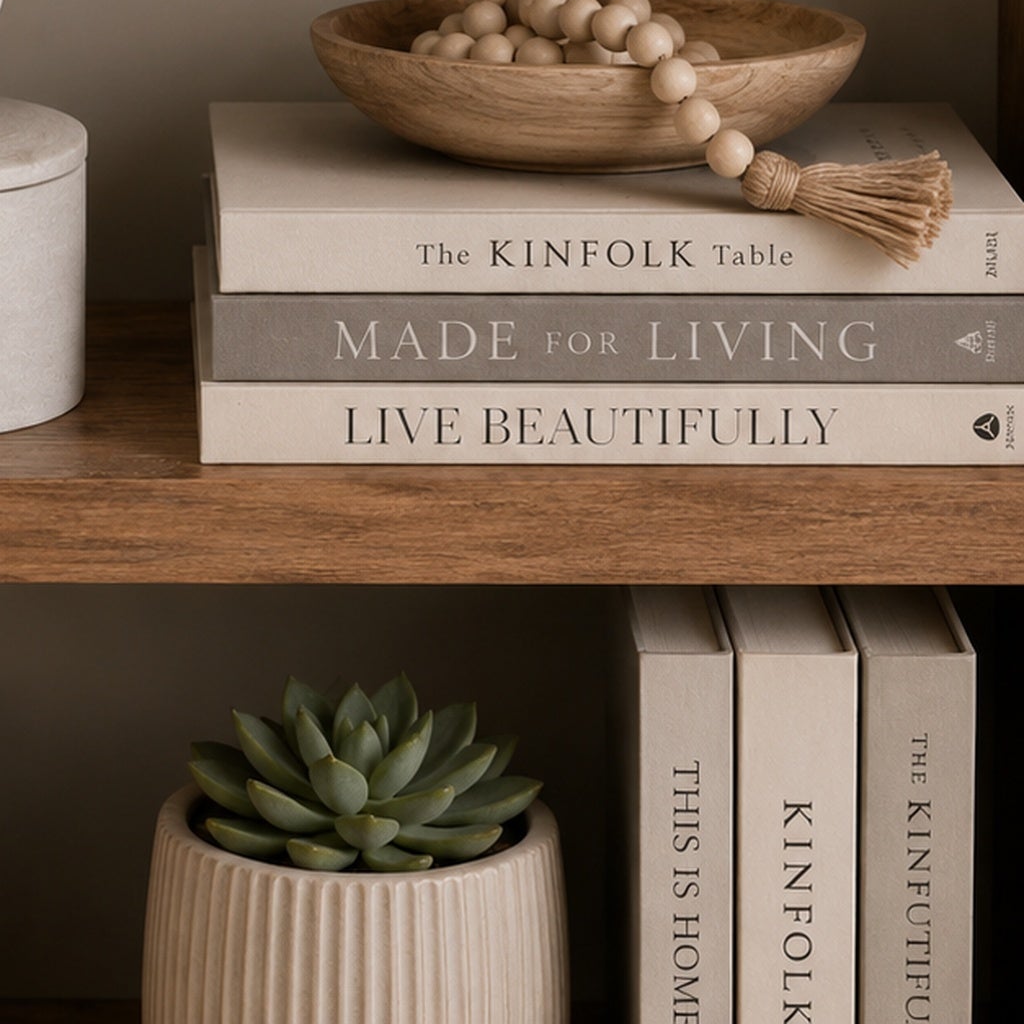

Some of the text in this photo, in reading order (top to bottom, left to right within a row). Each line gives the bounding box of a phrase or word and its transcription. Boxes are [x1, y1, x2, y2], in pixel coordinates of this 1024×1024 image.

[416, 239, 794, 268] The KINFOLK Table
[334, 320, 877, 362] MADE FOR LIVING
[345, 407, 839, 446] LIVE BEAUTIFULLY
[911, 733, 929, 785] THE
[672, 759, 700, 853] THIS
[672, 867, 700, 899] IS
[782, 799, 813, 1024] KINFOLK
